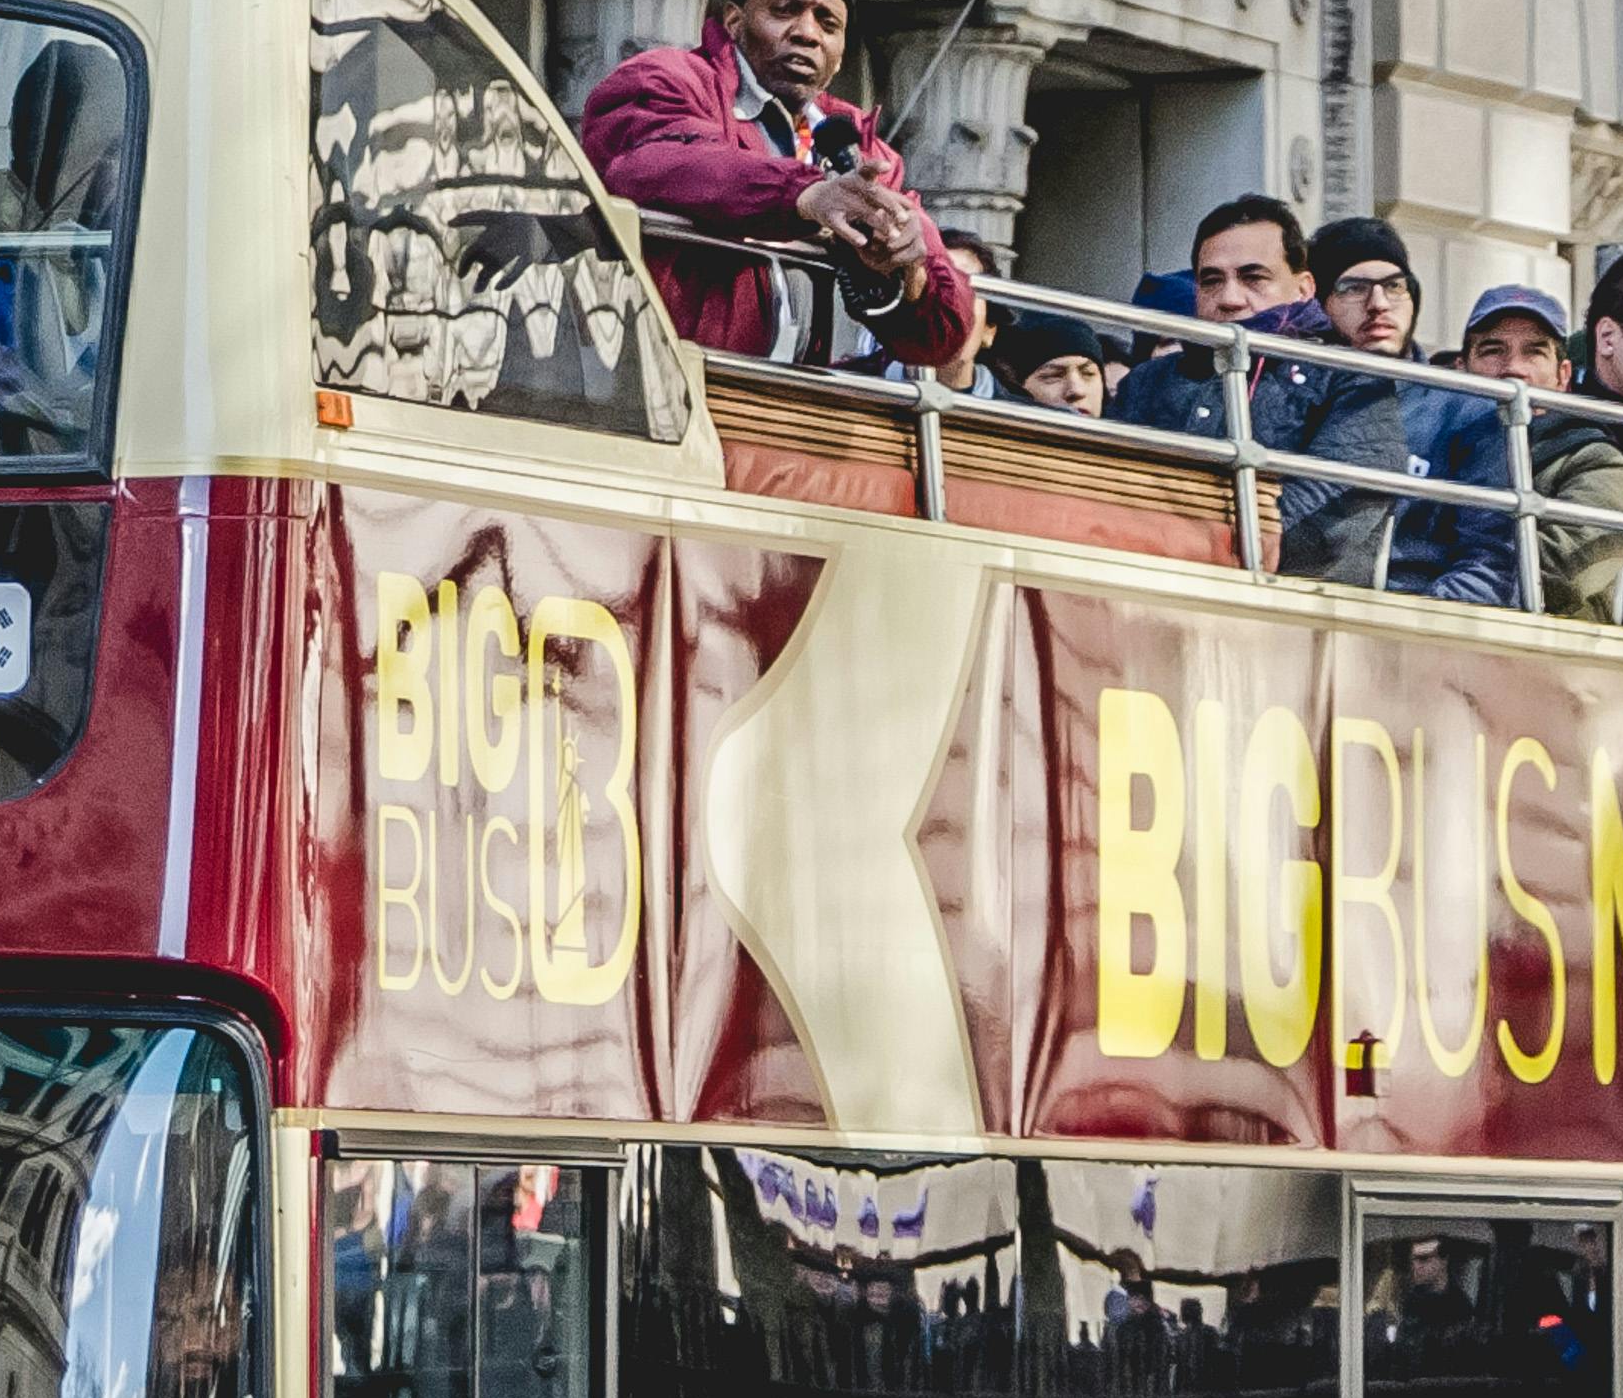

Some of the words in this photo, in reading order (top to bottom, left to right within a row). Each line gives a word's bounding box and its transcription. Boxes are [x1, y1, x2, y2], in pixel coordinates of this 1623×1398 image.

[377, 571, 521, 792] BIG
[378, 805, 522, 1000] BUS
[1097, 688, 1322, 1068] BIG
[1331, 716, 1566, 1083] BUS
